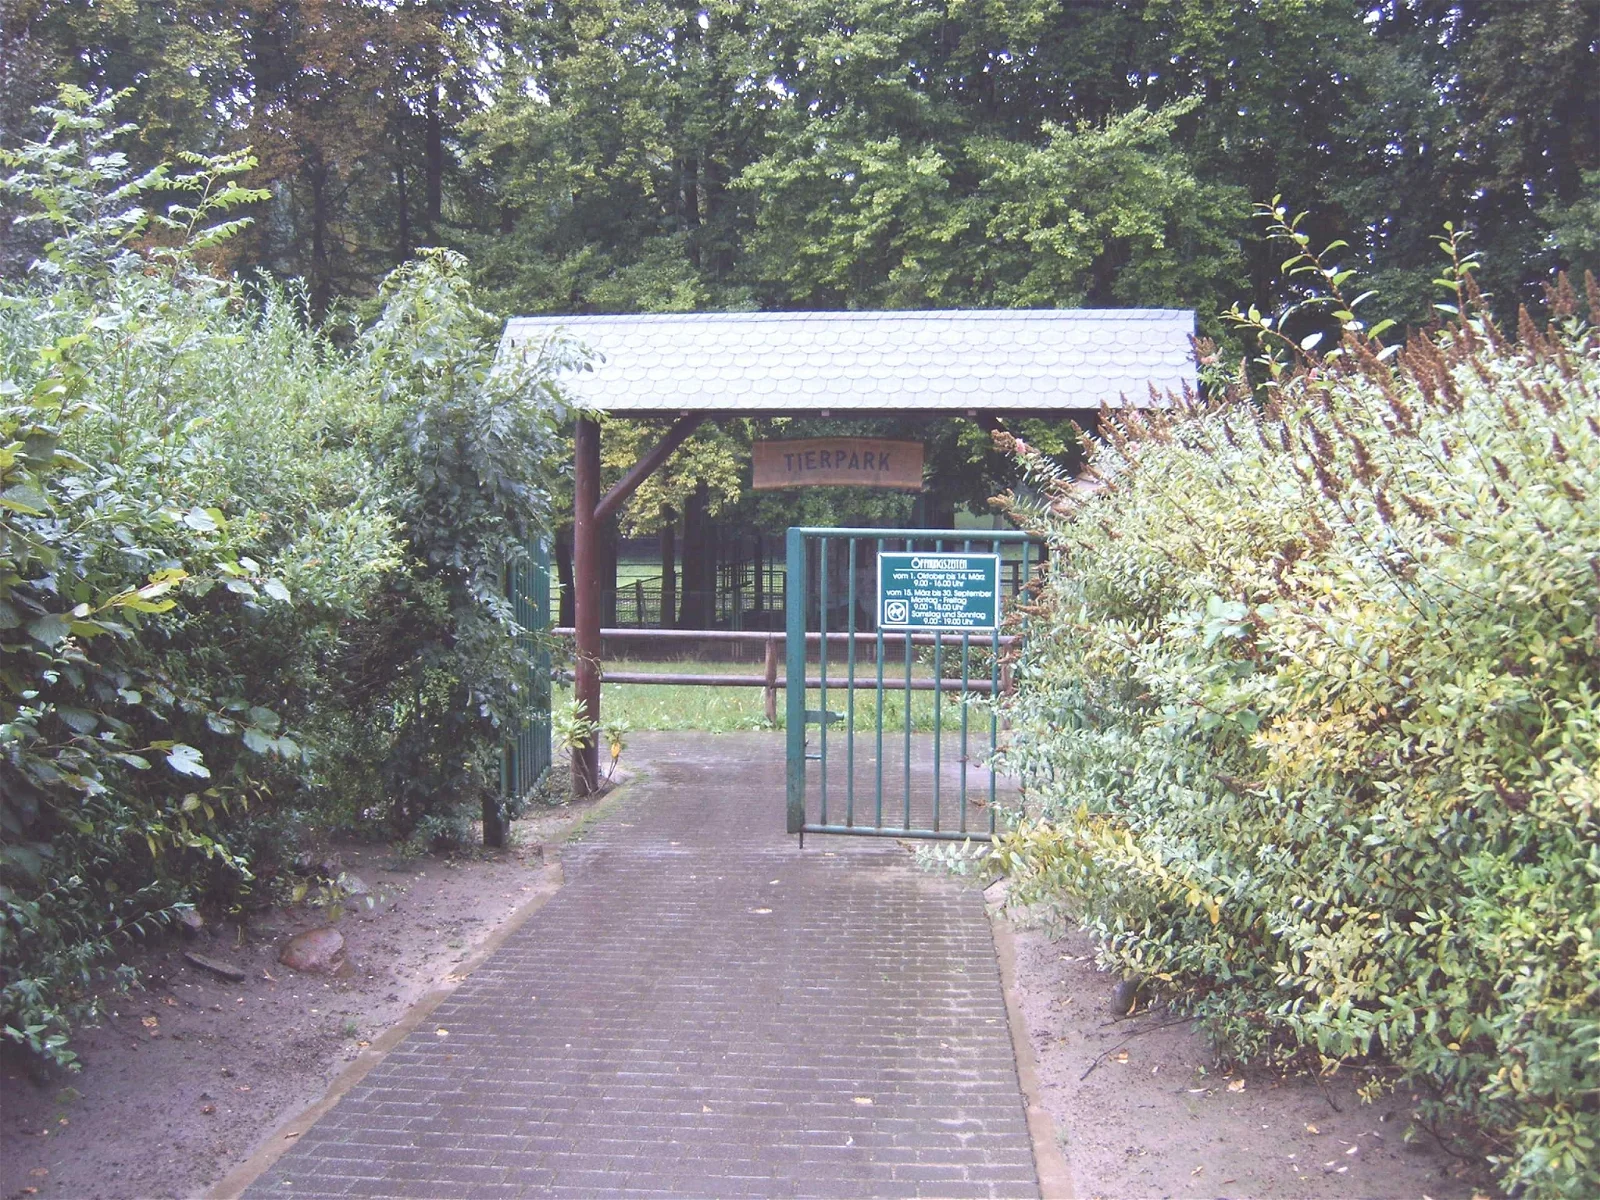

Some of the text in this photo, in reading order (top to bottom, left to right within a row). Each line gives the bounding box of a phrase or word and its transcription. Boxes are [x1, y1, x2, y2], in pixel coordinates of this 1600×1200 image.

[784, 450, 890, 472] TIERPARK
[943, 597, 967, 605] Freitag
[956, 611, 986, 619] Sonntag
